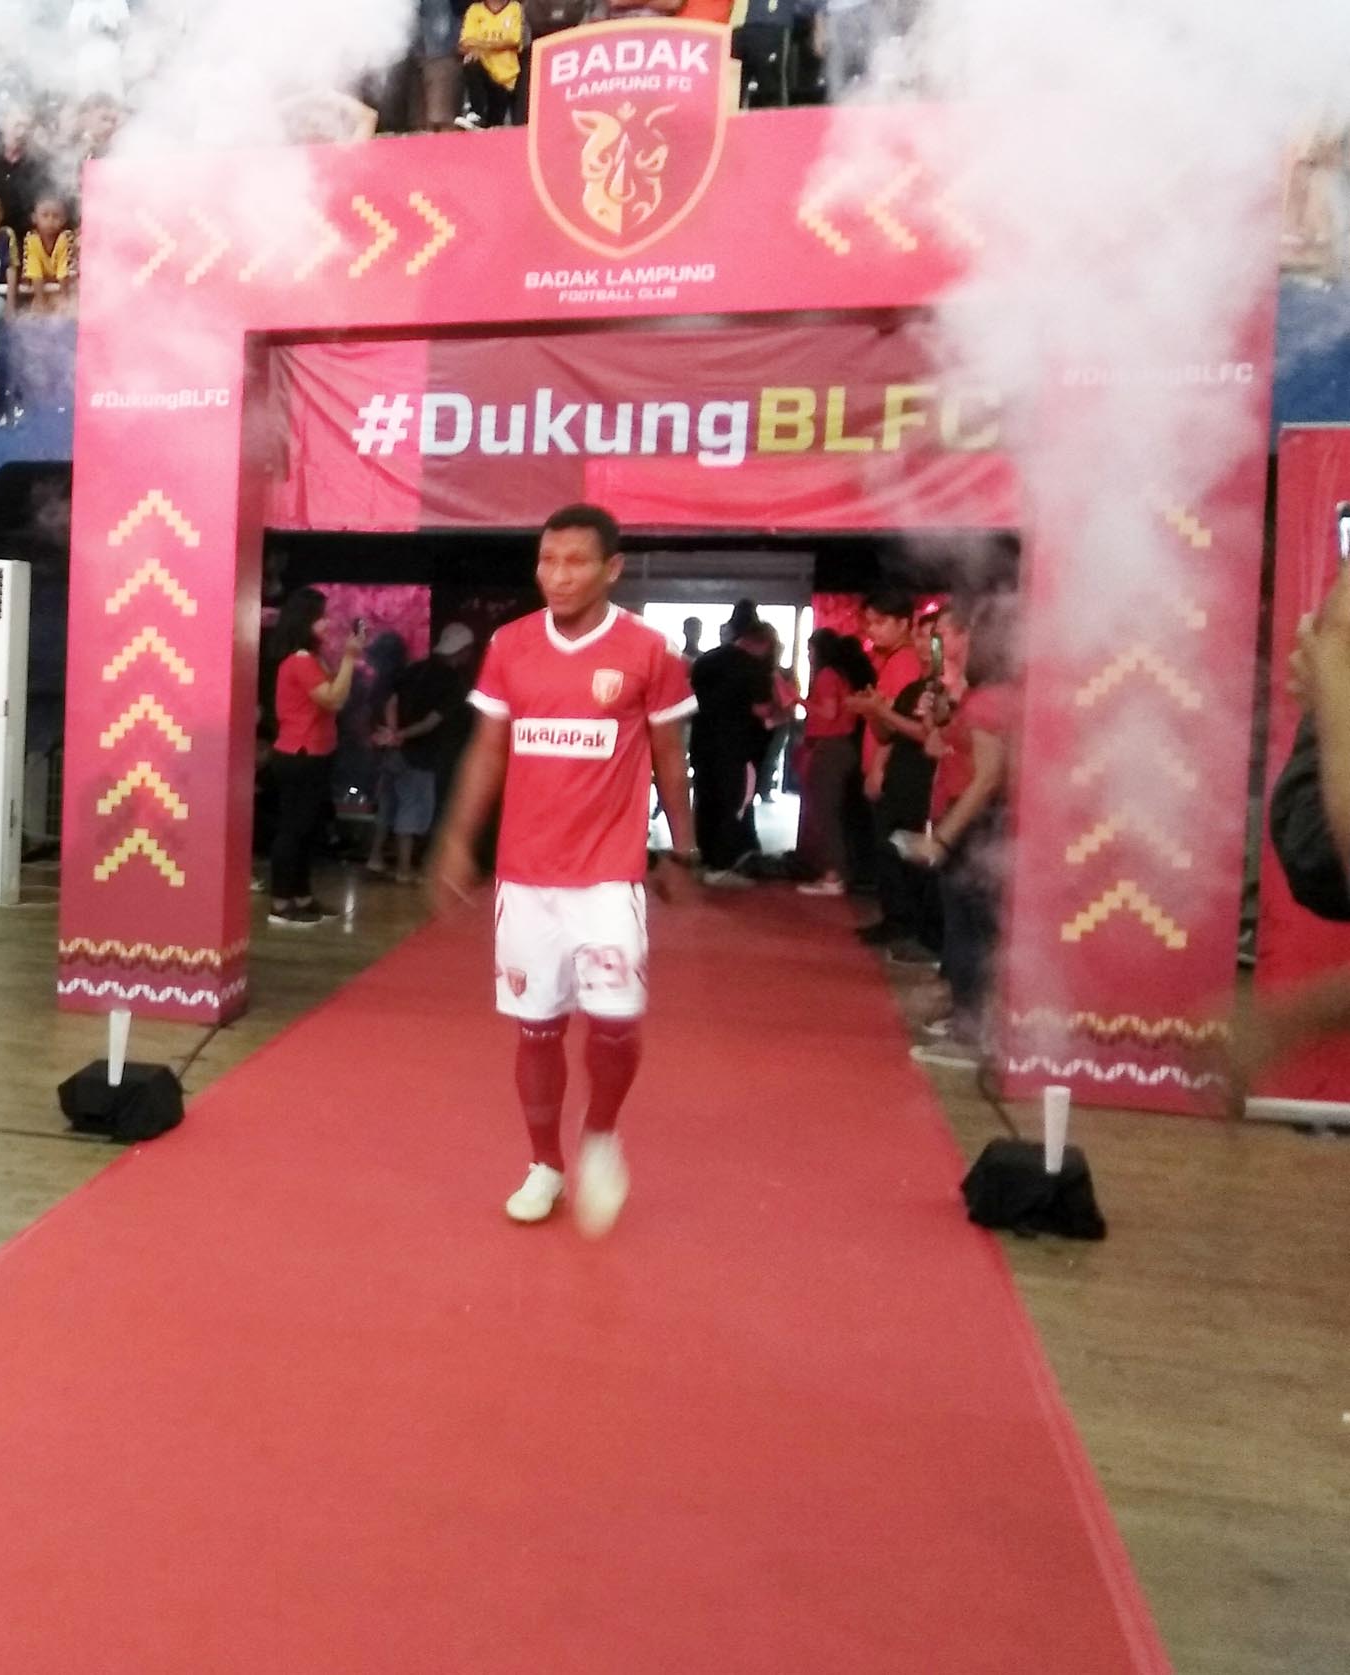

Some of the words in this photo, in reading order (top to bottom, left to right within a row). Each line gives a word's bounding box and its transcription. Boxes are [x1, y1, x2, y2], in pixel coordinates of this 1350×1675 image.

[550, 39, 710, 86] BADAK
[565, 75, 661, 101] LAMPUNG
[666, 74, 692, 93] FC
[524, 268, 599, 289] BADAK
[606, 263, 716, 286] LAMPUNG
[559, 288, 634, 303] FOOTBALL
[90, 388, 230, 410] #DukungBLFC
[351, 384, 1002, 467] #DukungBLFC
